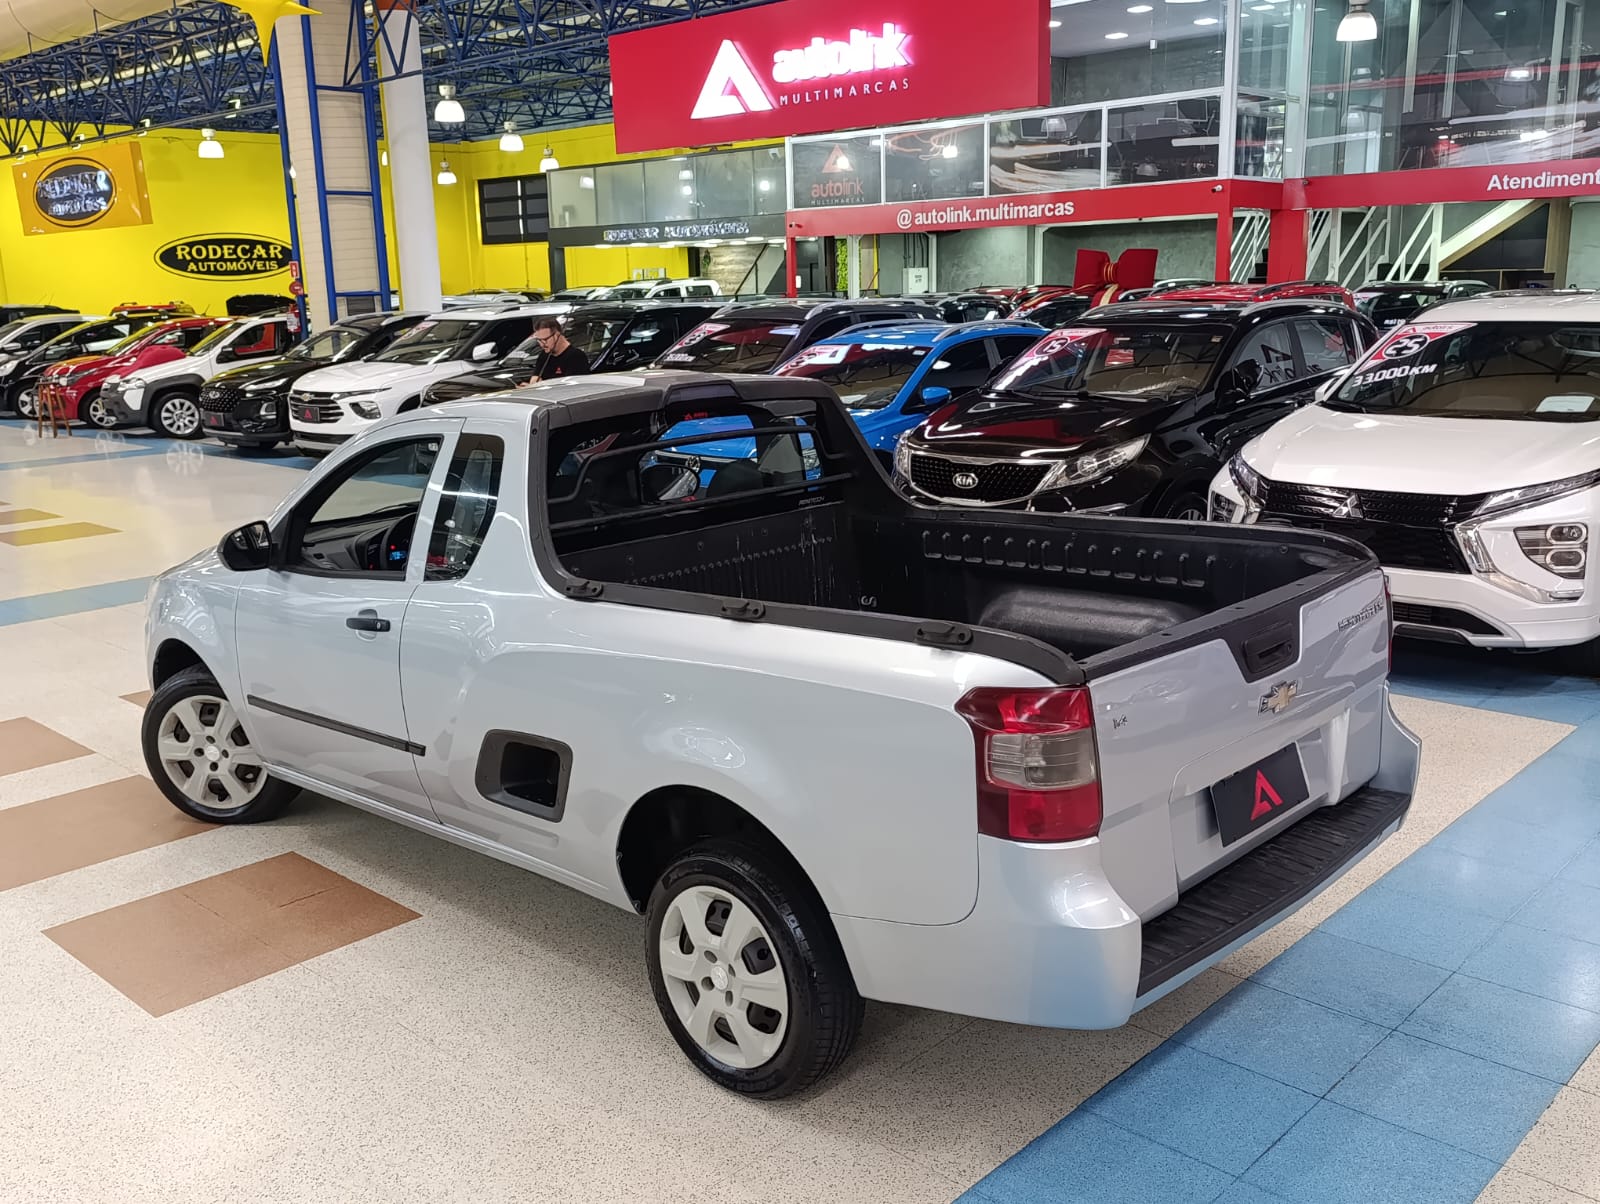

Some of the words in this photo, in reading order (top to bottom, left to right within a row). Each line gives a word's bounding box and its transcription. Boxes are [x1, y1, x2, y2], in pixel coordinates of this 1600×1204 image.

[772, 22, 911, 83] autolink
[779, 78, 909, 106] MULTIMARCAS
[811, 176, 864, 198] autolink
[176, 244, 283, 260] RODECAR
[187, 258, 279, 272] AUTOMÓVEIS
[1385, 337, 1426, 356] 25
[955, 475, 974, 486] KIA
